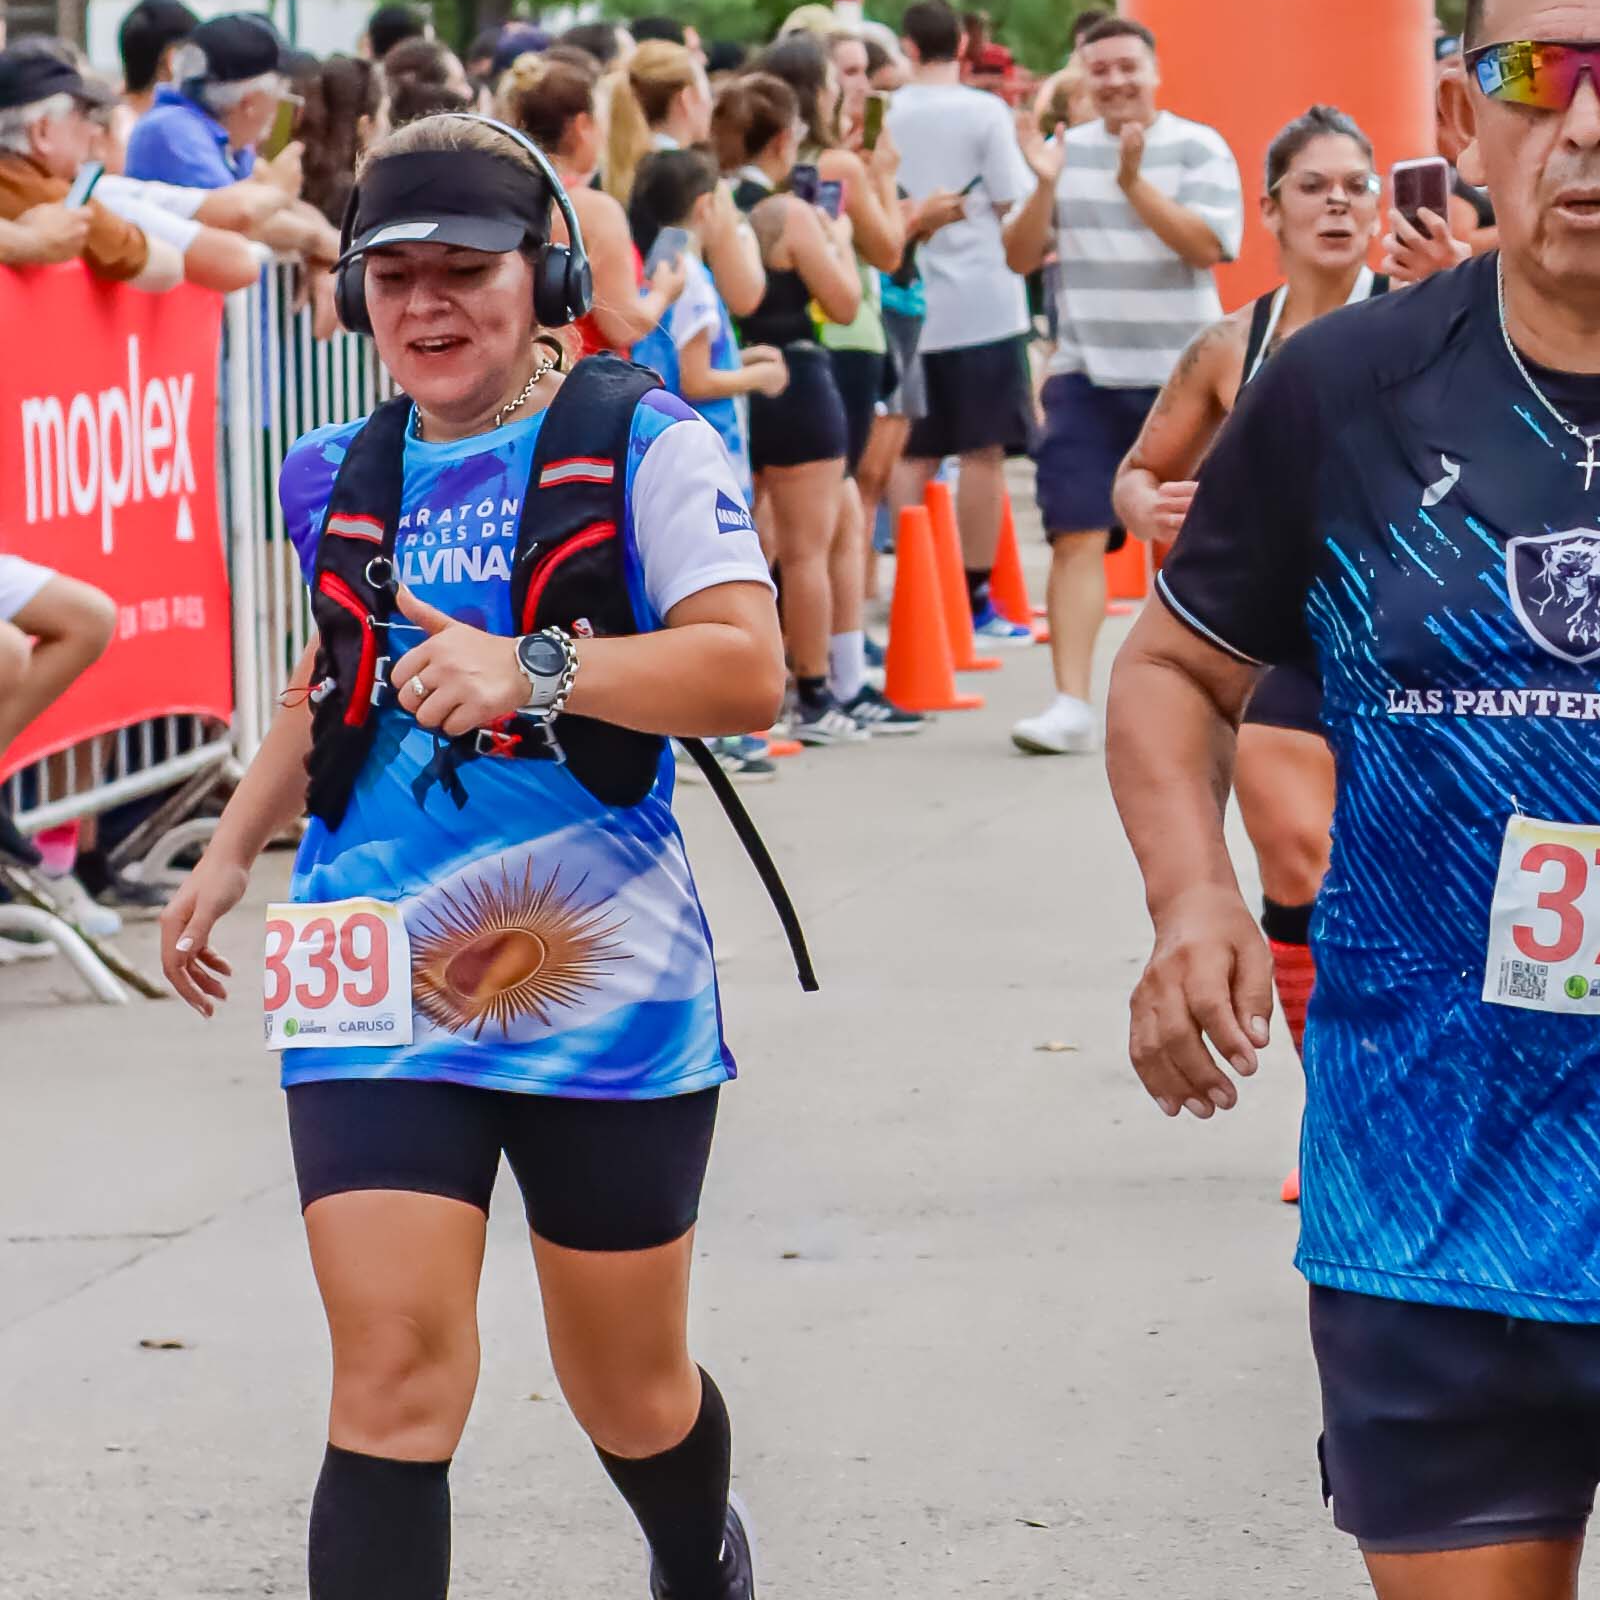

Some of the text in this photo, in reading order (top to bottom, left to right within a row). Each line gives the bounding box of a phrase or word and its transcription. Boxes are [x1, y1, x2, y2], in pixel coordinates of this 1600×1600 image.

[21, 334, 196, 554] moplex
[398, 497, 519, 529] ARATÓN
[395, 521, 515, 547] ROES DE
[393, 544, 515, 585] LVINA
[1386, 688, 1443, 715] LAS
[264, 912, 390, 1012] 339
[337, 1019, 395, 1034] CARUSO
